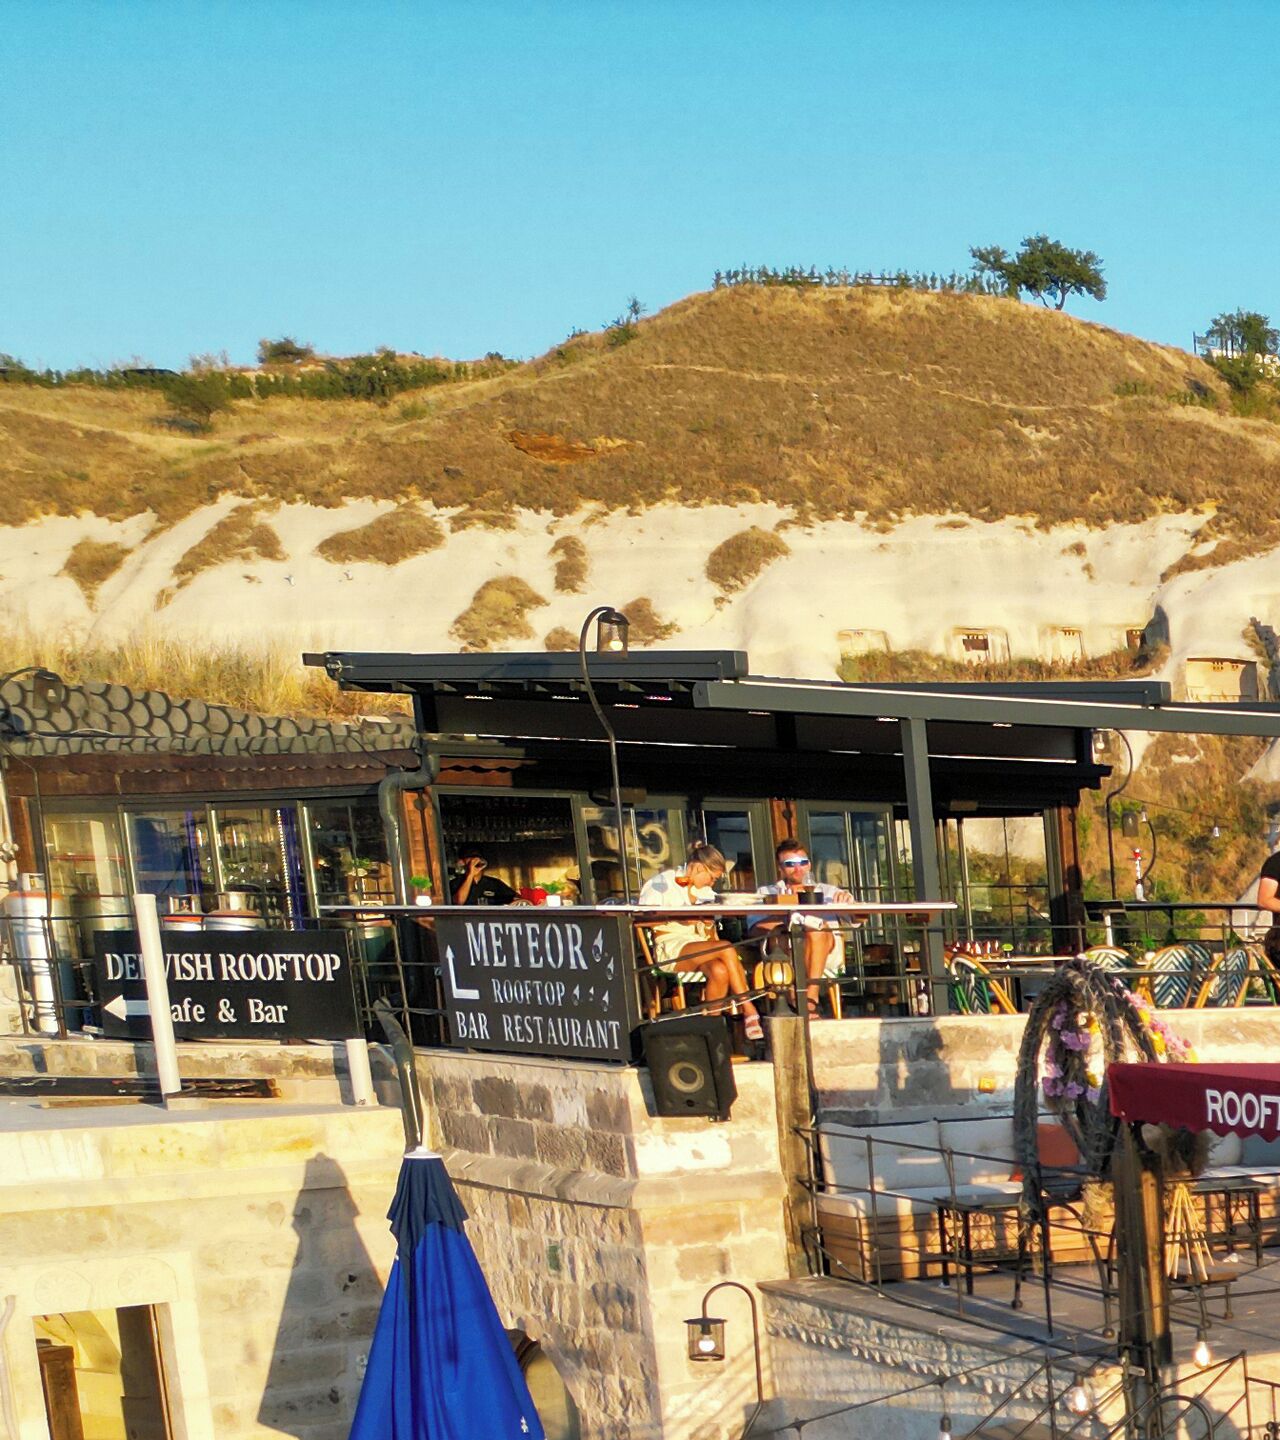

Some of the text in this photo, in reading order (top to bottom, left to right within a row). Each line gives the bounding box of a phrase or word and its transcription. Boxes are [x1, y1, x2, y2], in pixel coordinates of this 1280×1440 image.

[465, 922, 588, 970] METEOR
[219, 953, 341, 982] ROOFTOP
[491, 978, 566, 1007] ROOFTOP
[170, 997, 288, 1024] afe & Bar
[456, 1011, 620, 1050] BAR RESTAURANT
